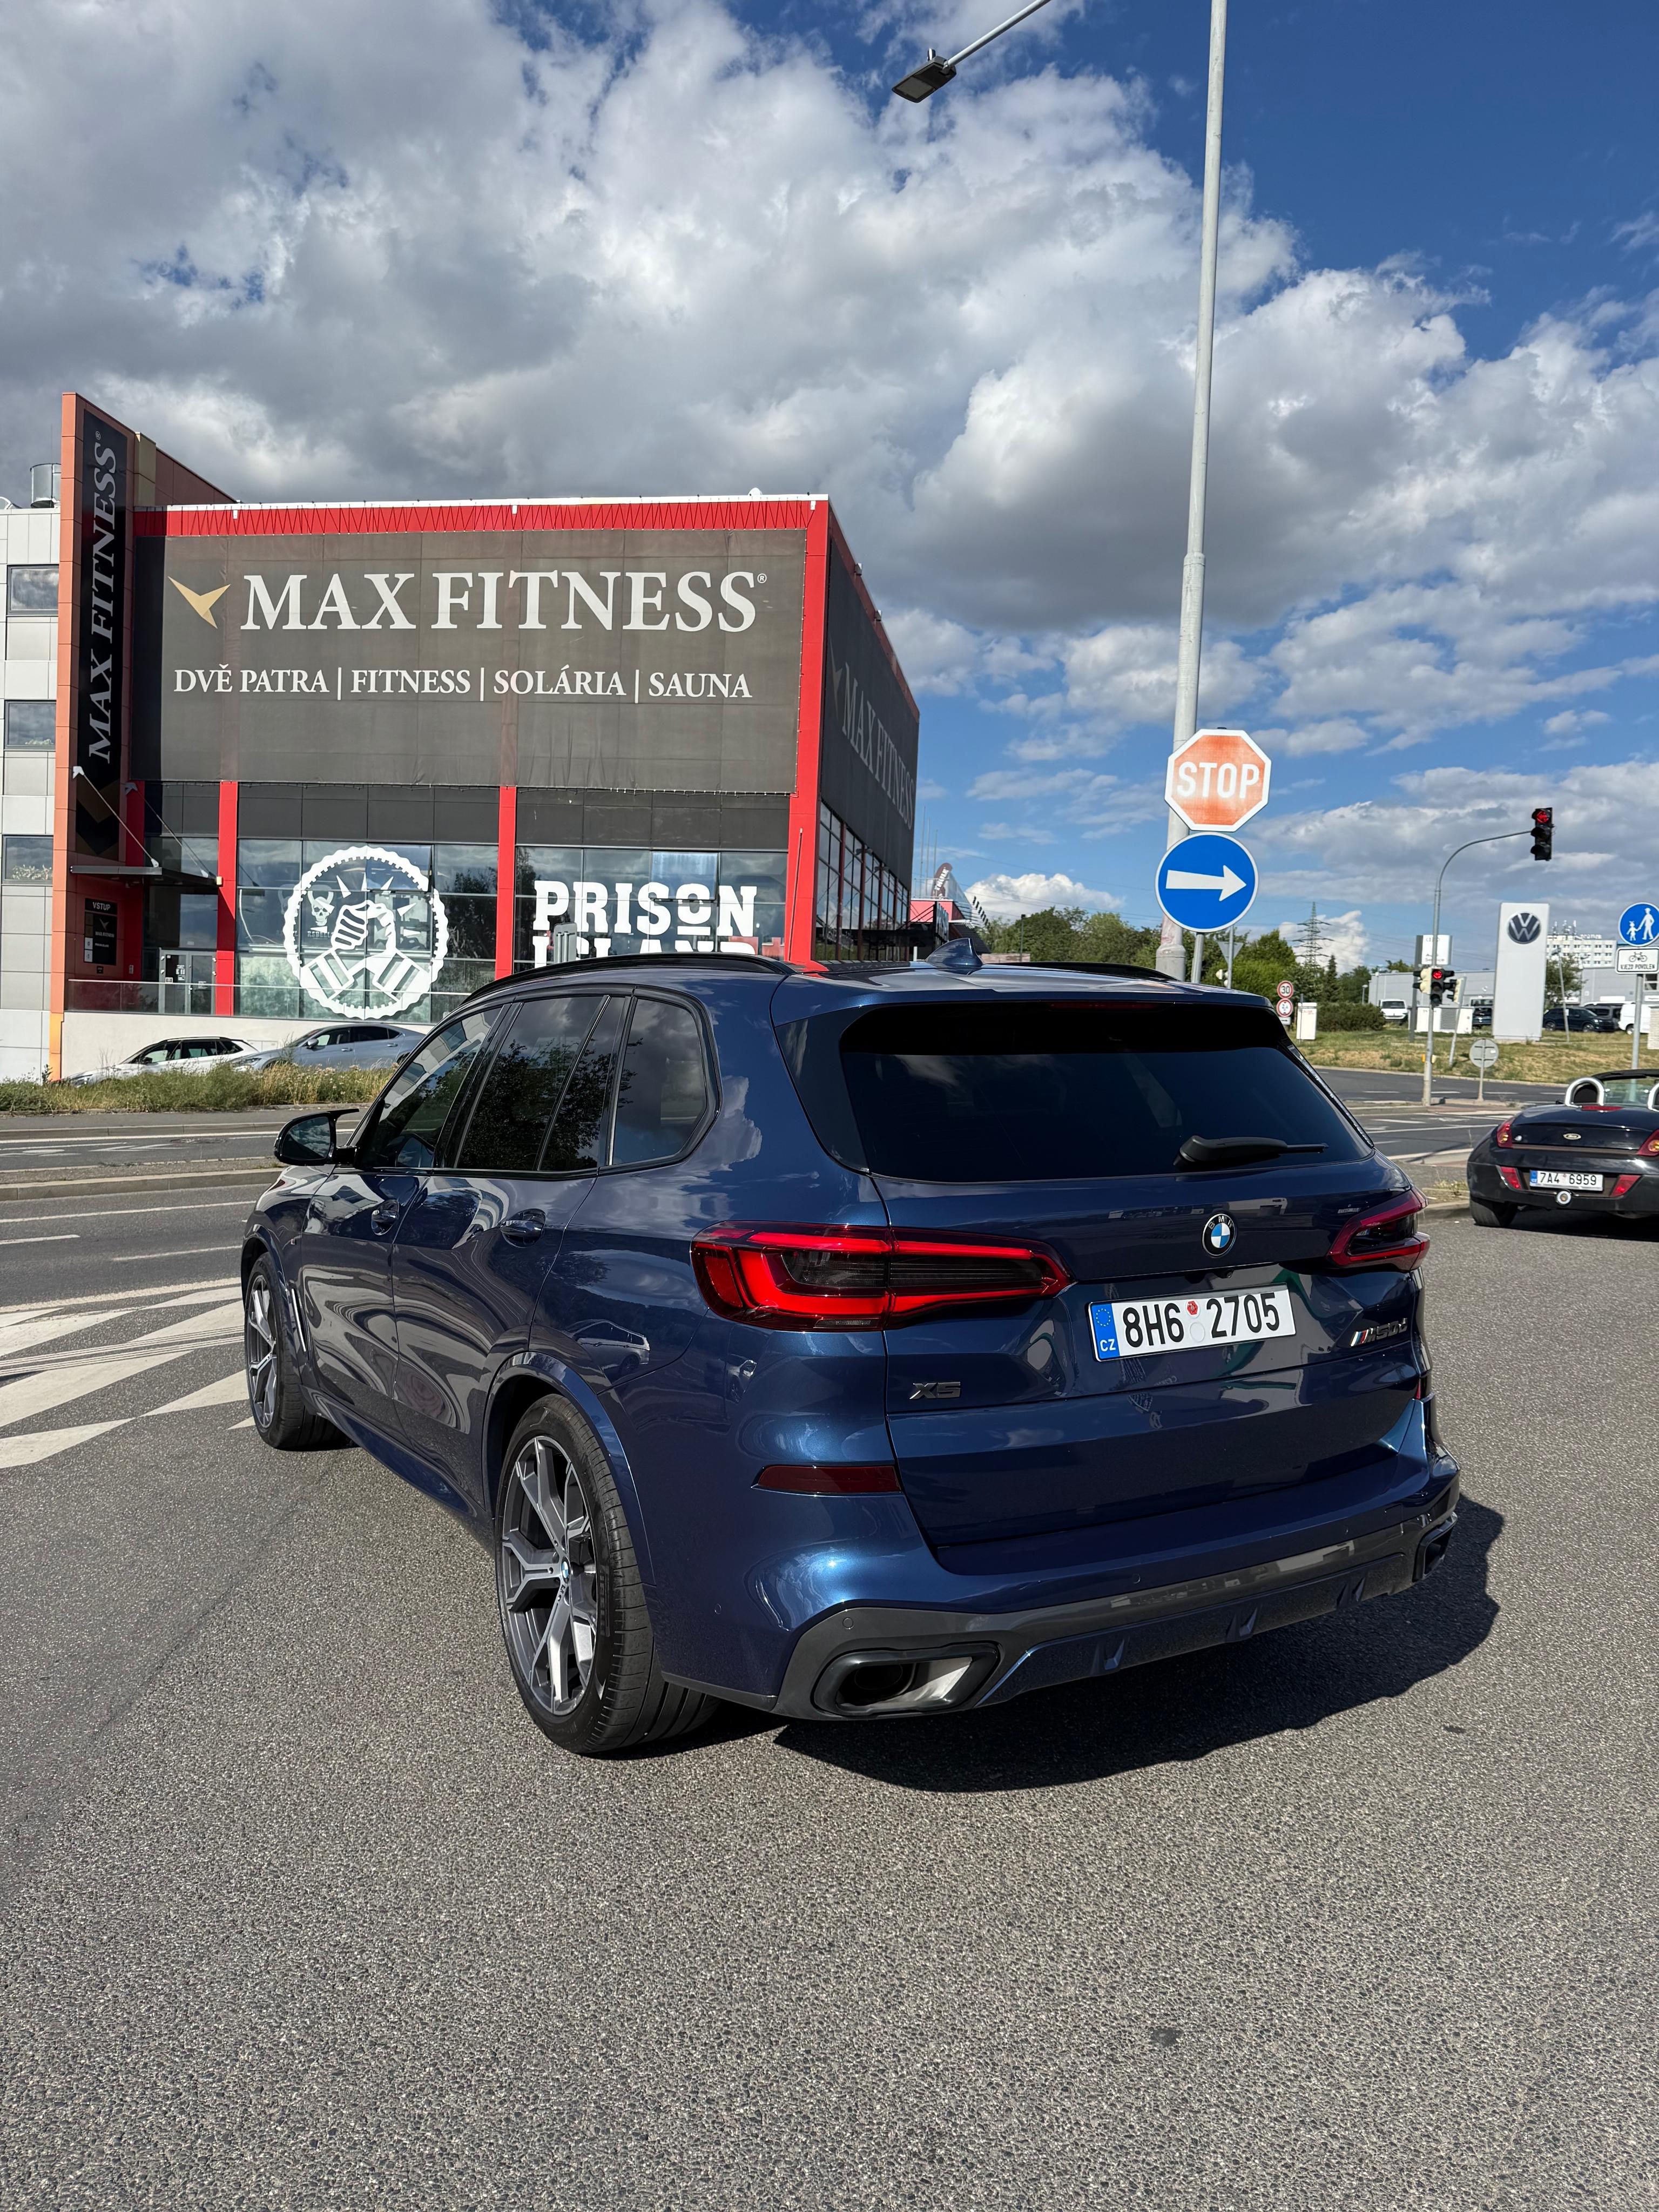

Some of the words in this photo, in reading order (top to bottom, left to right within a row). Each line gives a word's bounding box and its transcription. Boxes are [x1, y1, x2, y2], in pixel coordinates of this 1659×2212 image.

[240, 573, 416, 630] MAX
[173, 663, 233, 693] DVĚ
[240, 669, 330, 693] PATRA
[350, 669, 471, 694] FITNESS
[493, 664, 626, 696] SOLÁRIA
[649, 672, 753, 698] SAUNA
[88, 648, 112, 764] MAX
[842, 662, 876, 774] MAX
[875, 718, 915, 830] FITNESS
[1176, 761, 1260, 799] STOP
[93, 901, 111, 911] VSTUP
[532, 880, 757, 937] PRISON
[1281, 986, 1290, 994] 30
[1540, 1172, 1560, 1183] 7A4
[1569, 1174, 1596, 1185] 6959
[1100, 1339, 1116, 1352] CZ
[1123, 1303, 1184, 1348] 8H6
[1206, 1292, 1280, 1338] 2705
[909, 1381, 961, 1400] X5
